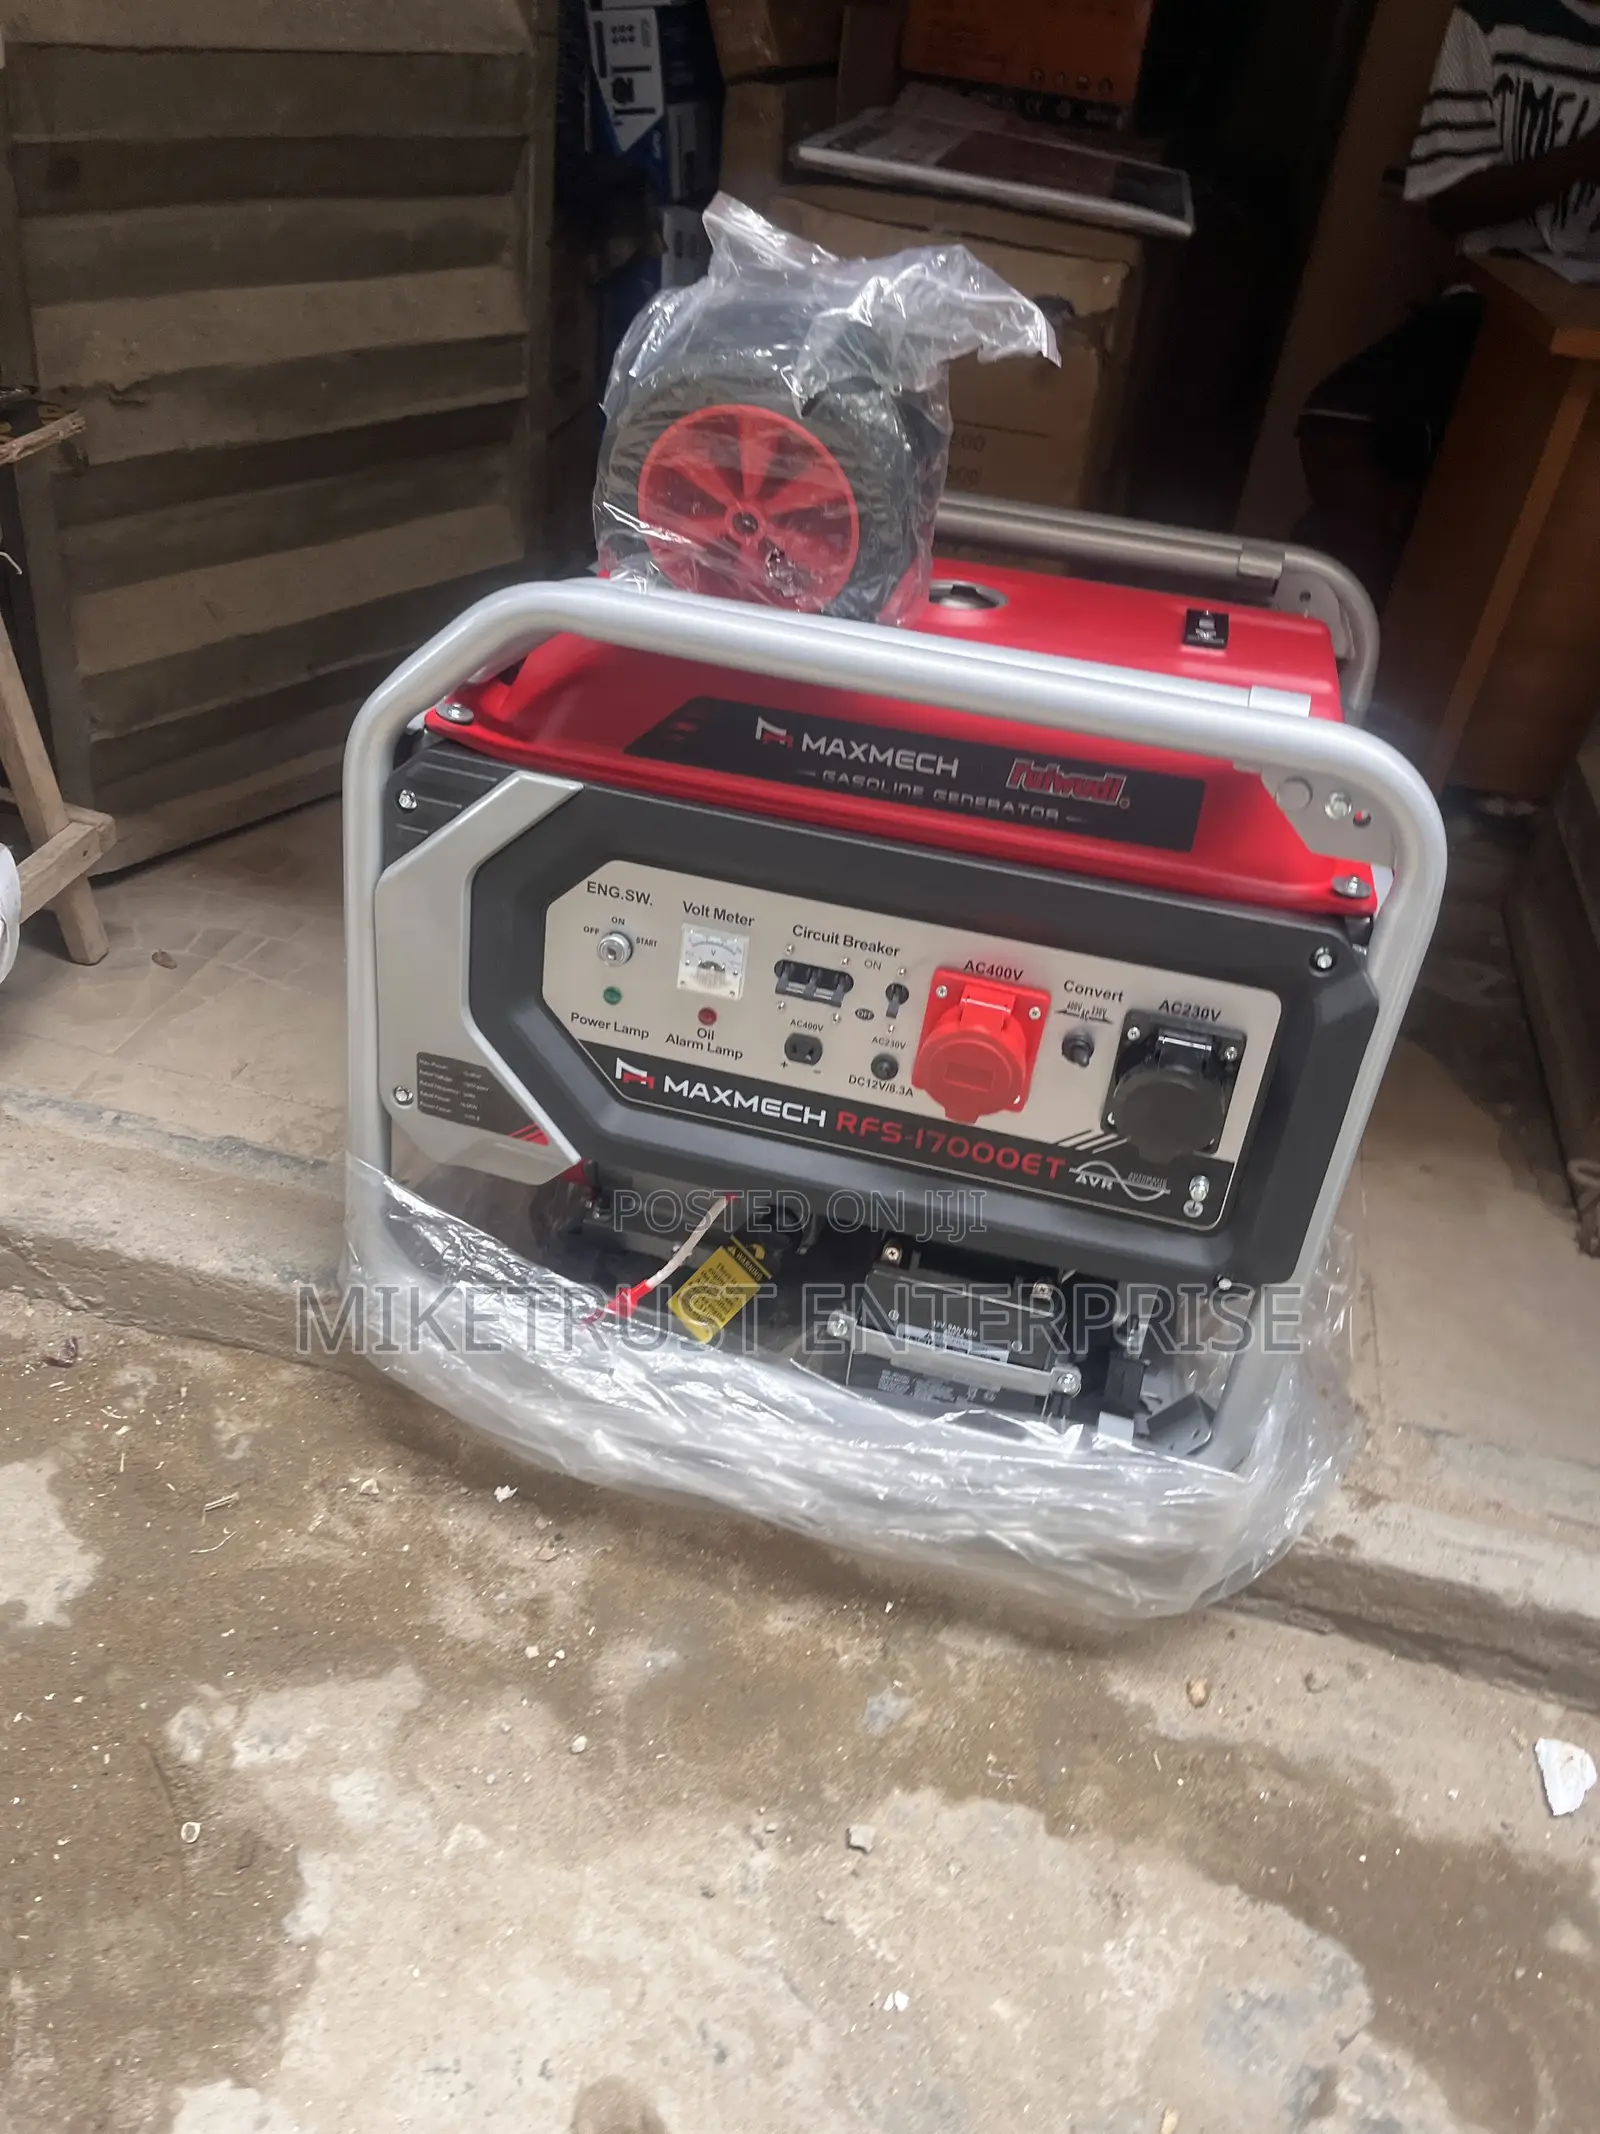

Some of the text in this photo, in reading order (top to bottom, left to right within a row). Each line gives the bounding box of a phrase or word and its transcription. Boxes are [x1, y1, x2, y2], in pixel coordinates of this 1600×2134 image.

[801, 732, 959, 779] MAXMECH
[822, 769, 1060, 823] GASOLINE GENERATOR
[586, 879, 654, 908] ENG.SW.
[611, 916, 626, 927] ON
[682, 900, 755, 927] Volt Meter
[583, 925, 600, 937] OFF
[635, 936, 658, 949] START
[792, 922, 901, 958] Circuit Breaker
[863, 958, 883, 971] ON
[963, 958, 1024, 983] AC400V
[1063, 979, 1125, 1004] Convert
[1158, 998, 1222, 1024] AC230V
[570, 1011, 650, 1040] Power Lamp
[696, 1026, 715, 1041] Oil
[789, 1017, 824, 1033] AC400V
[665, 1032, 744, 1061] Alarm Lamp
[871, 1035, 906, 1051] AC230V
[663, 1074, 1067, 1180] MAXMECH RFS-17000ET
